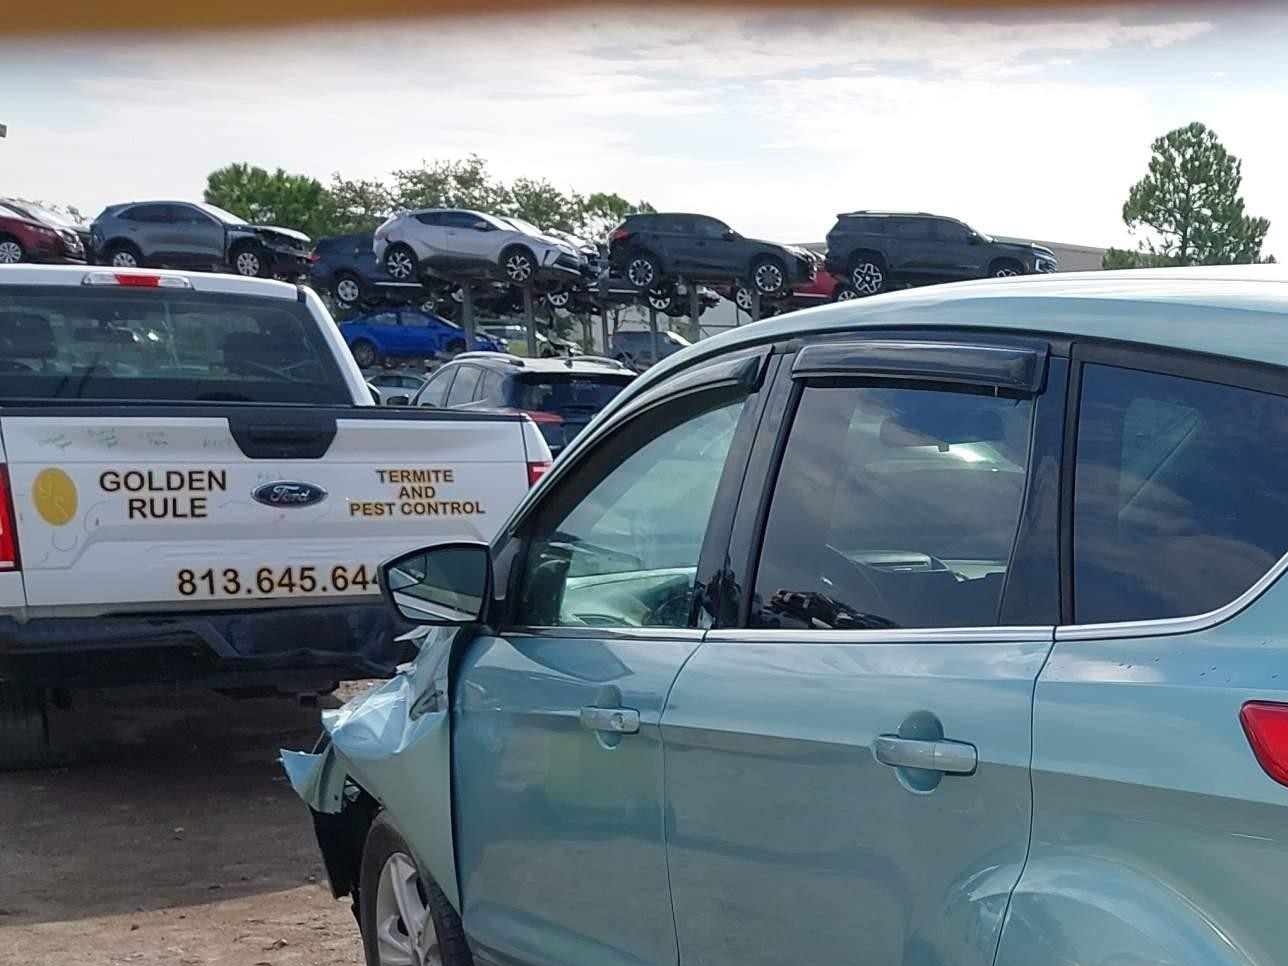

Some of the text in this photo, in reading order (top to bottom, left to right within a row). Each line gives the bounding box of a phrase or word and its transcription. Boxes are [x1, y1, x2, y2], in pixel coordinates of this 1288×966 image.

[99, 470, 227, 492] GOLDEN
[375, 468, 454, 484] TERMITE
[398, 486, 436, 499] AND
[128, 497, 208, 519] RULE
[350, 501, 486, 517] PEST CONTROL
